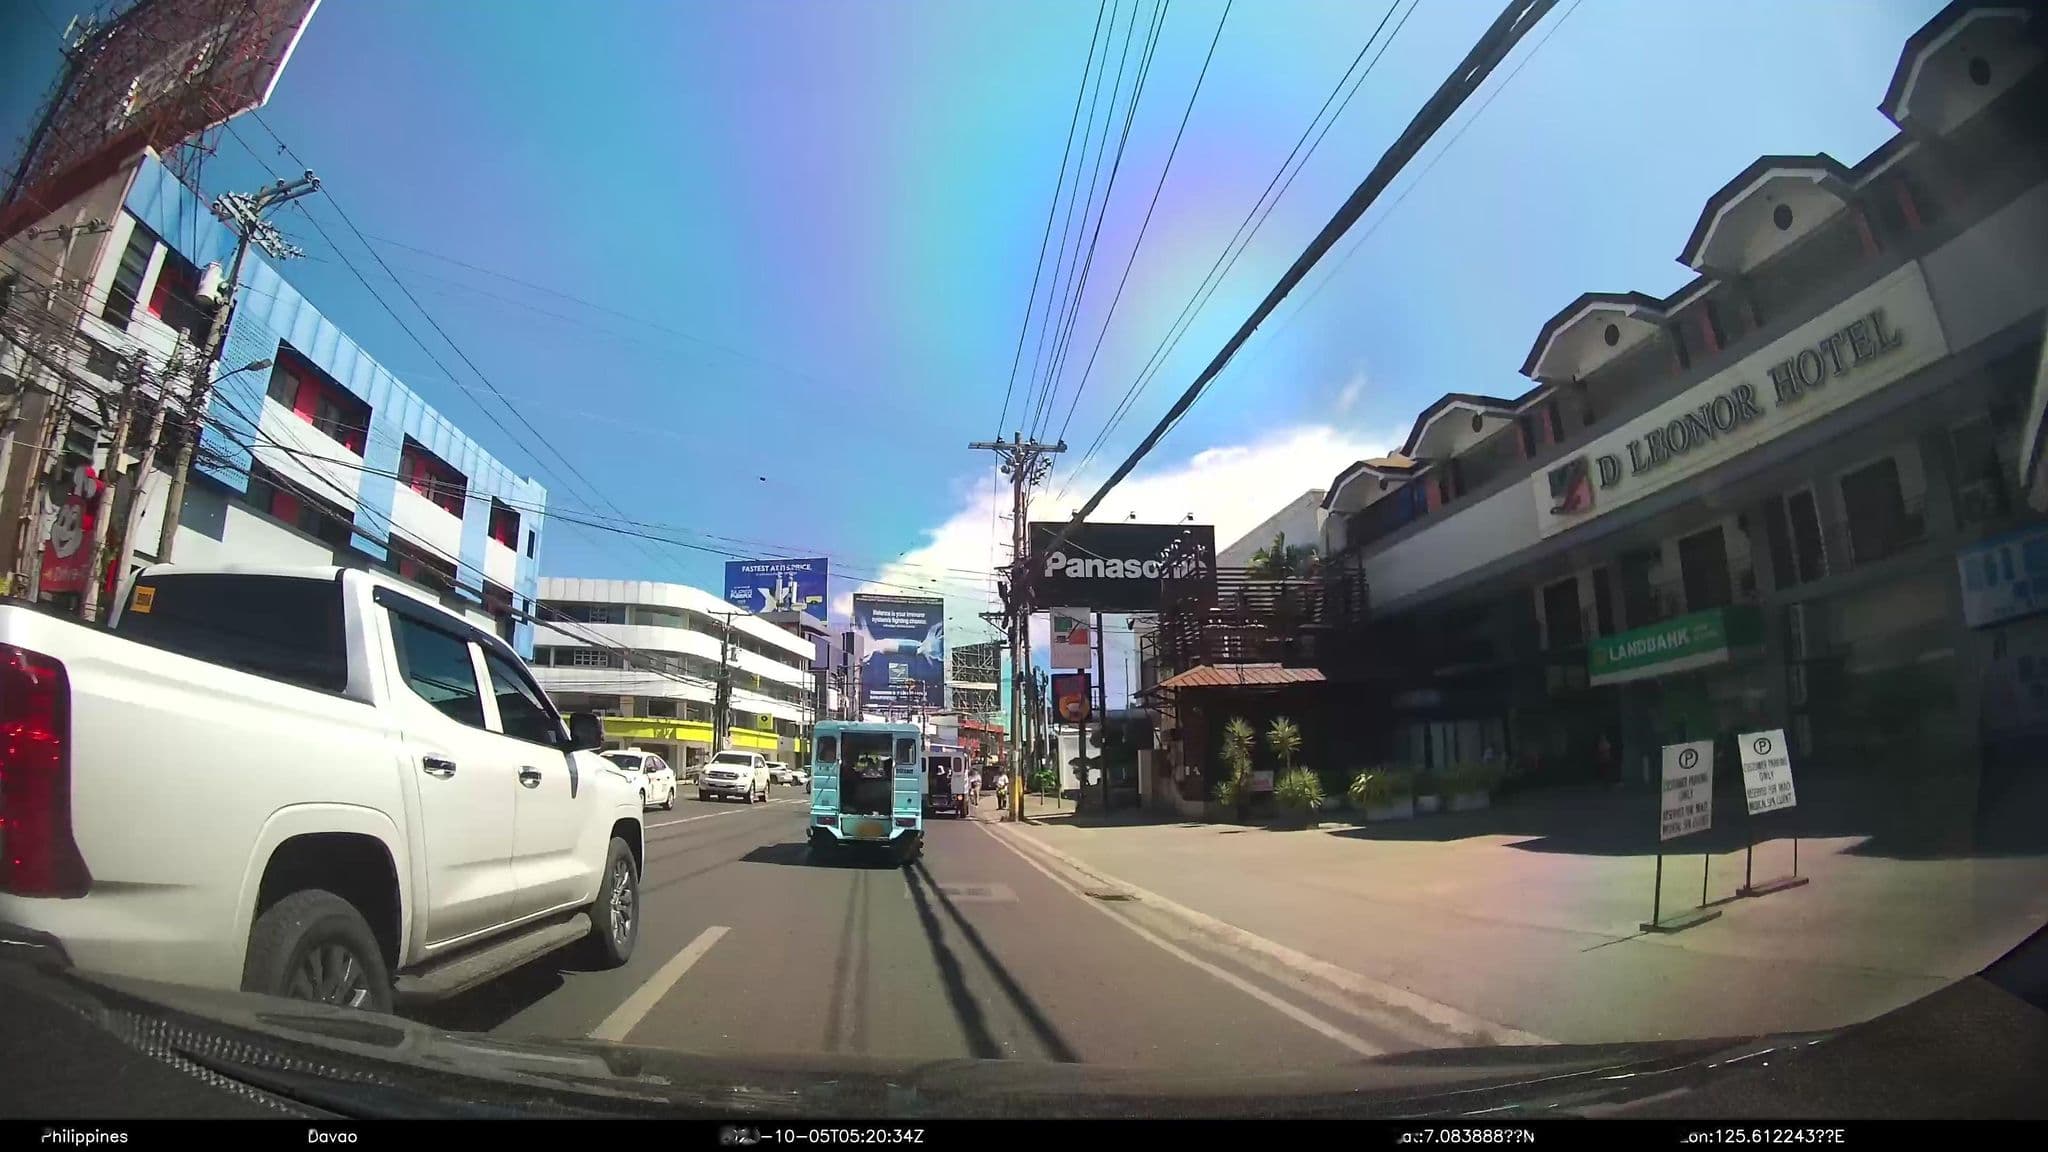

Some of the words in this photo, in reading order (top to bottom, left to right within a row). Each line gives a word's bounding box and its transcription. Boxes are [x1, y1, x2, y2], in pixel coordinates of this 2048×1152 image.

[1595, 455, 1621, 489] D
[1626, 382, 1766, 474] LEONOR
[1767, 309, 1902, 408] HOTEL
[742, 565, 769, 573] FASTEST
